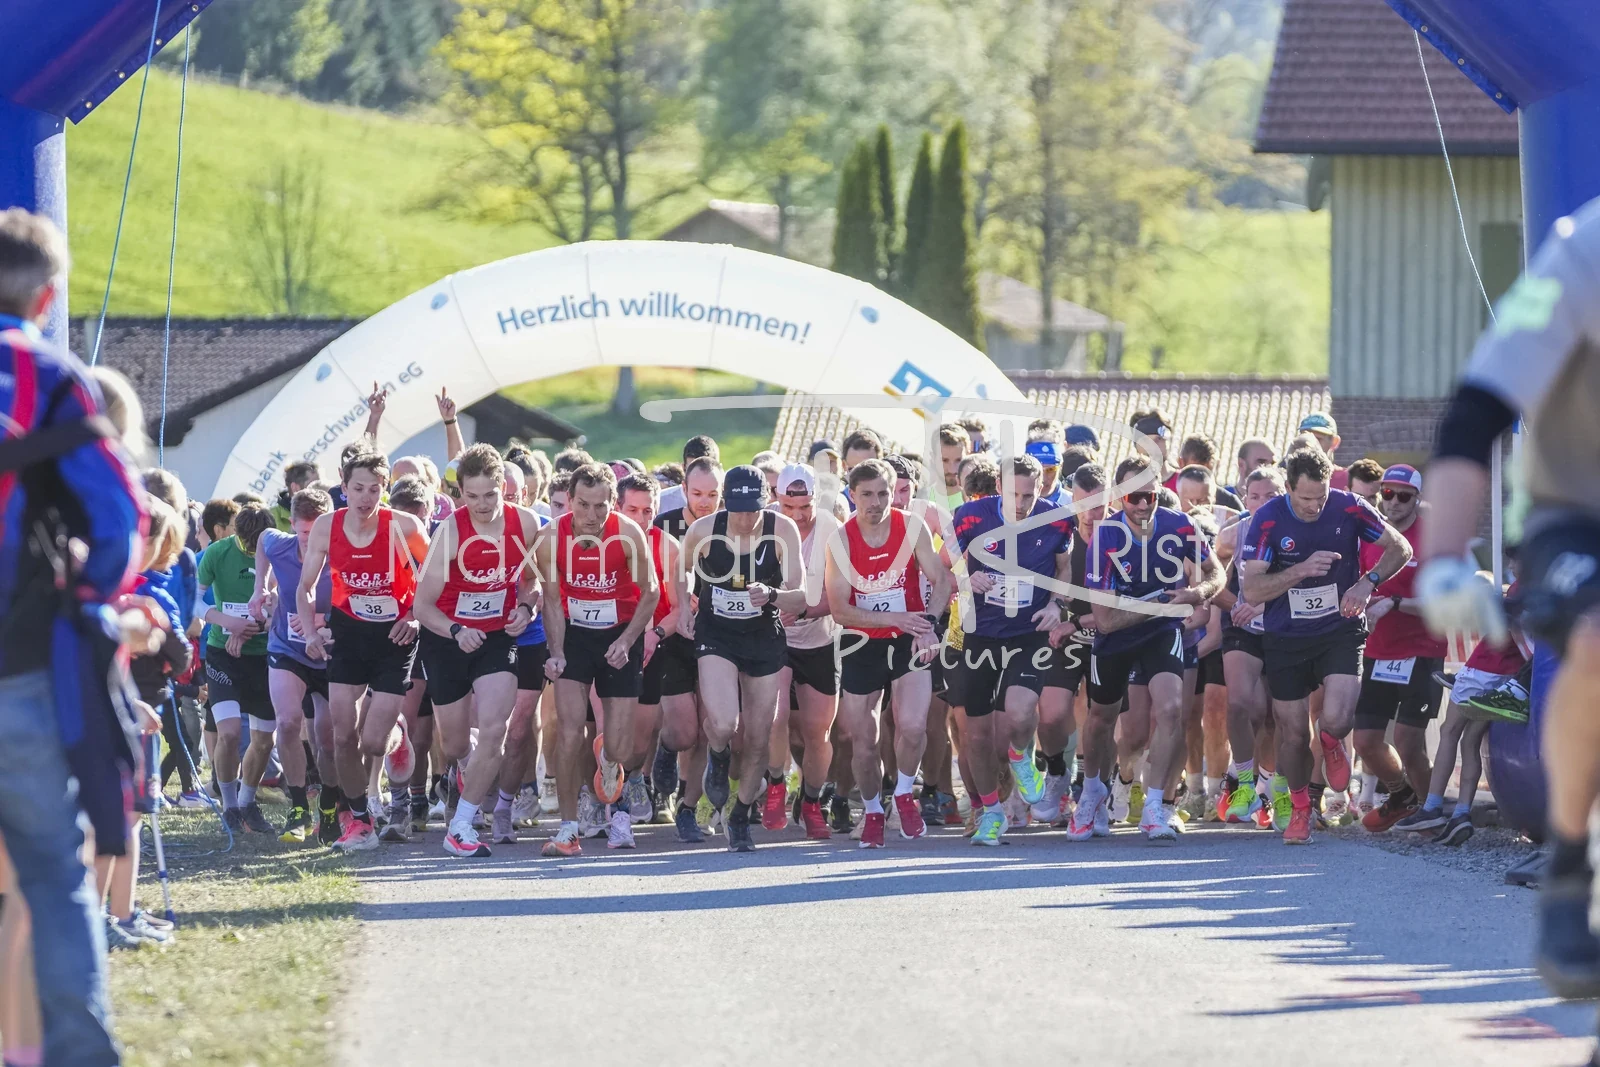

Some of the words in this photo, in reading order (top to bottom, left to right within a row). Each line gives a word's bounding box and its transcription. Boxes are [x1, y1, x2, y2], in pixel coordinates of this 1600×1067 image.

[496, 291, 610, 335] Herzlich
[618, 291, 812, 345] willkommen!
[398, 360, 424, 385] eG
[341, 571, 392, 582] SPORT
[857, 567, 907, 583] SPORT
[999, 585, 1016, 599] 21
[364, 603, 383, 615] 38
[471, 600, 491, 612] 24
[726, 601, 746, 612] 28
[872, 601, 891, 613] 42
[1304, 597, 1324, 610] 32
[582, 609, 601, 621] 77
[1386, 660, 1402, 673] 44
